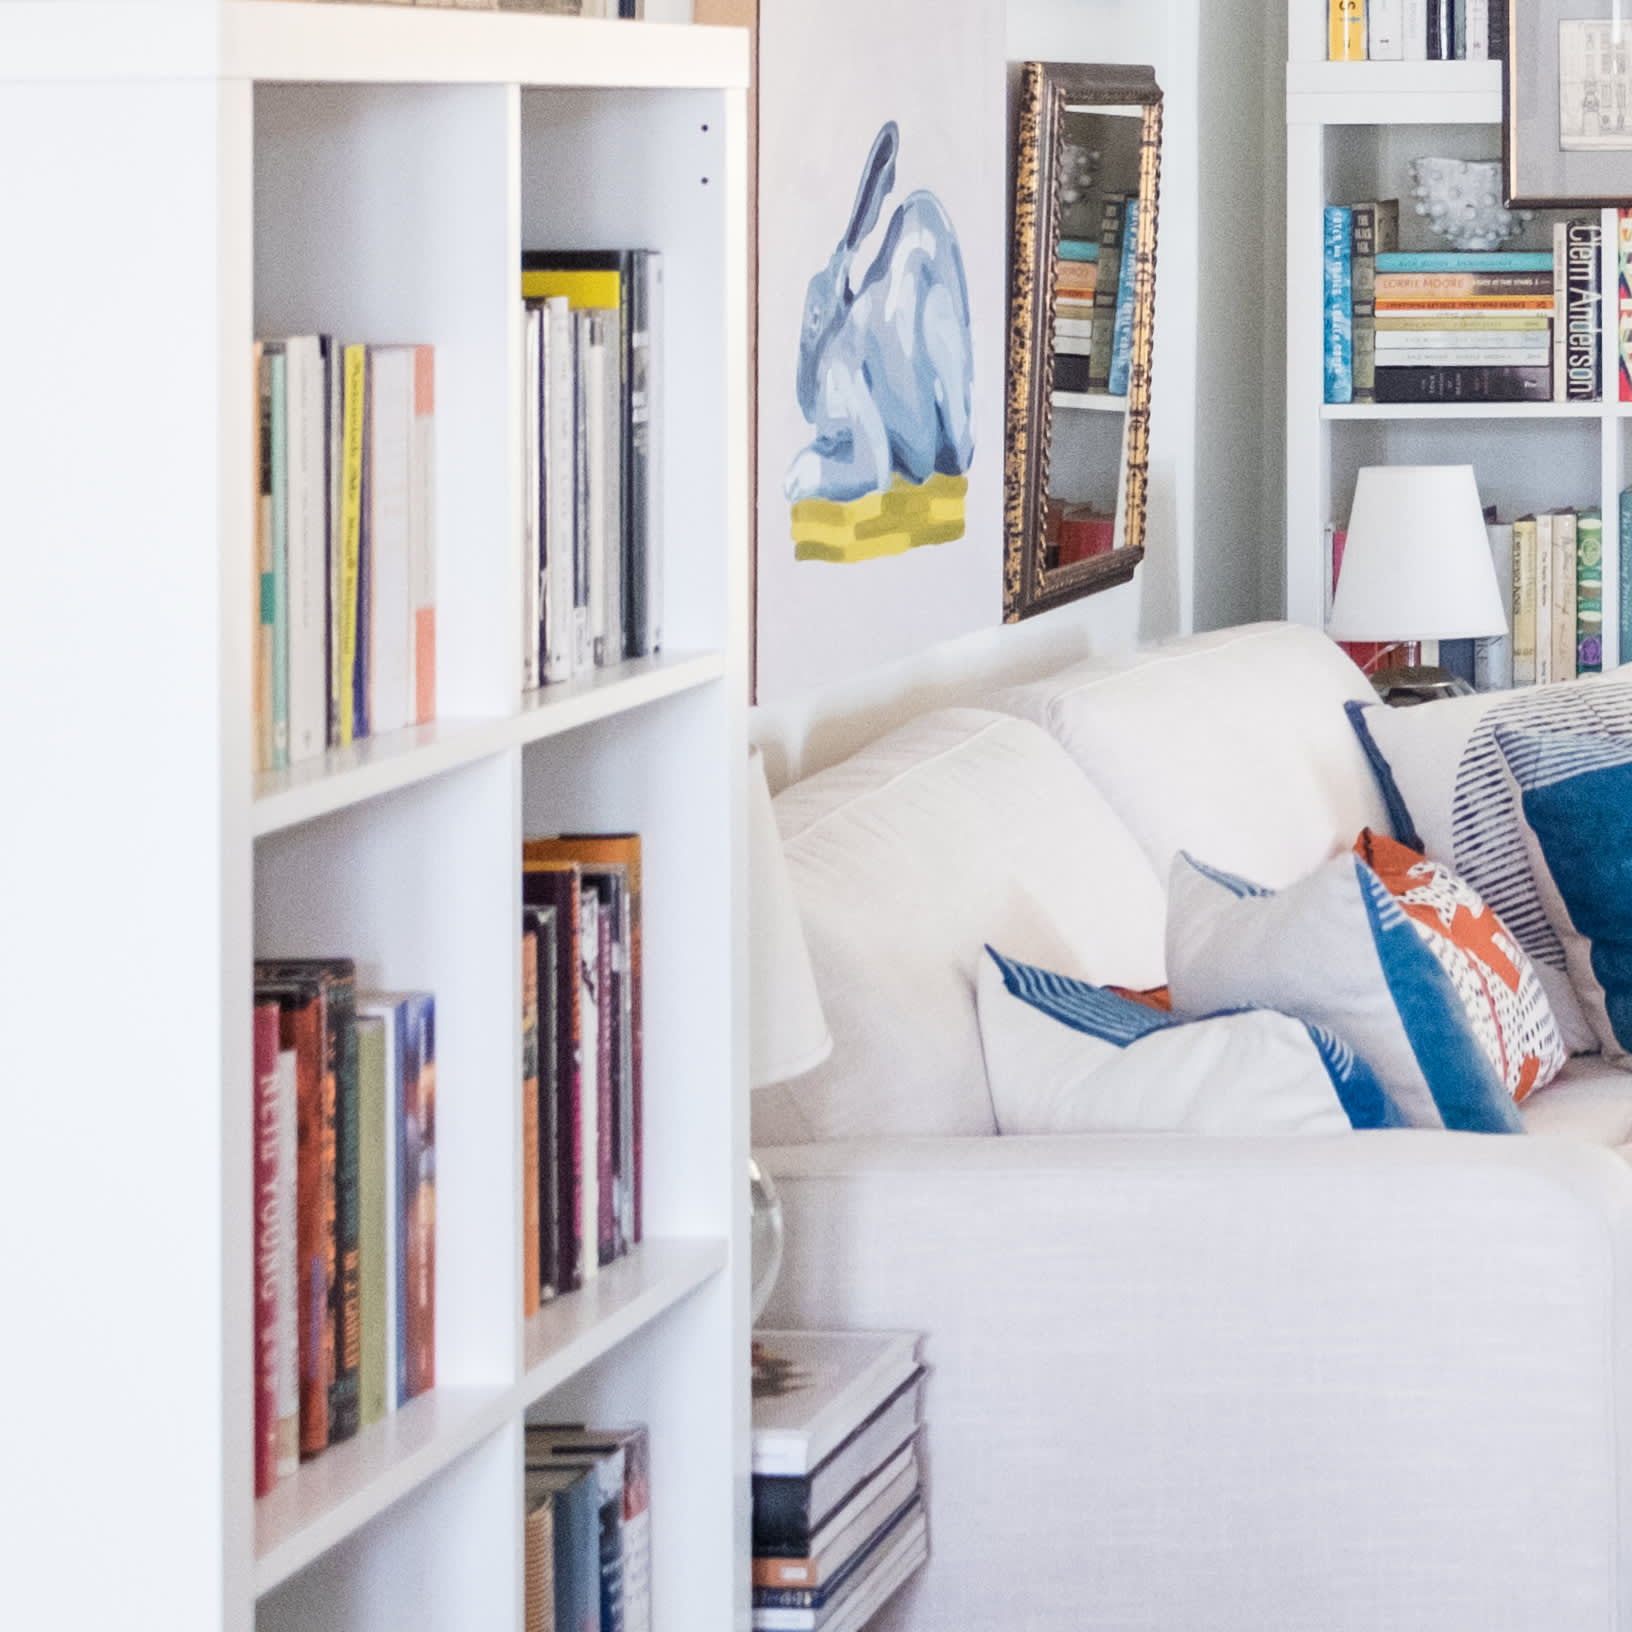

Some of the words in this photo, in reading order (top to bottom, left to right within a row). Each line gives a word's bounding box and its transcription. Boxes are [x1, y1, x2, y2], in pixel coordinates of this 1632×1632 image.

[1422, 277, 1465, 289] MOORE
[1567, 225, 1602, 280] Clem
[1567, 288, 1602, 394] Anderson
[262, 1180, 282, 1302] YOUNG
